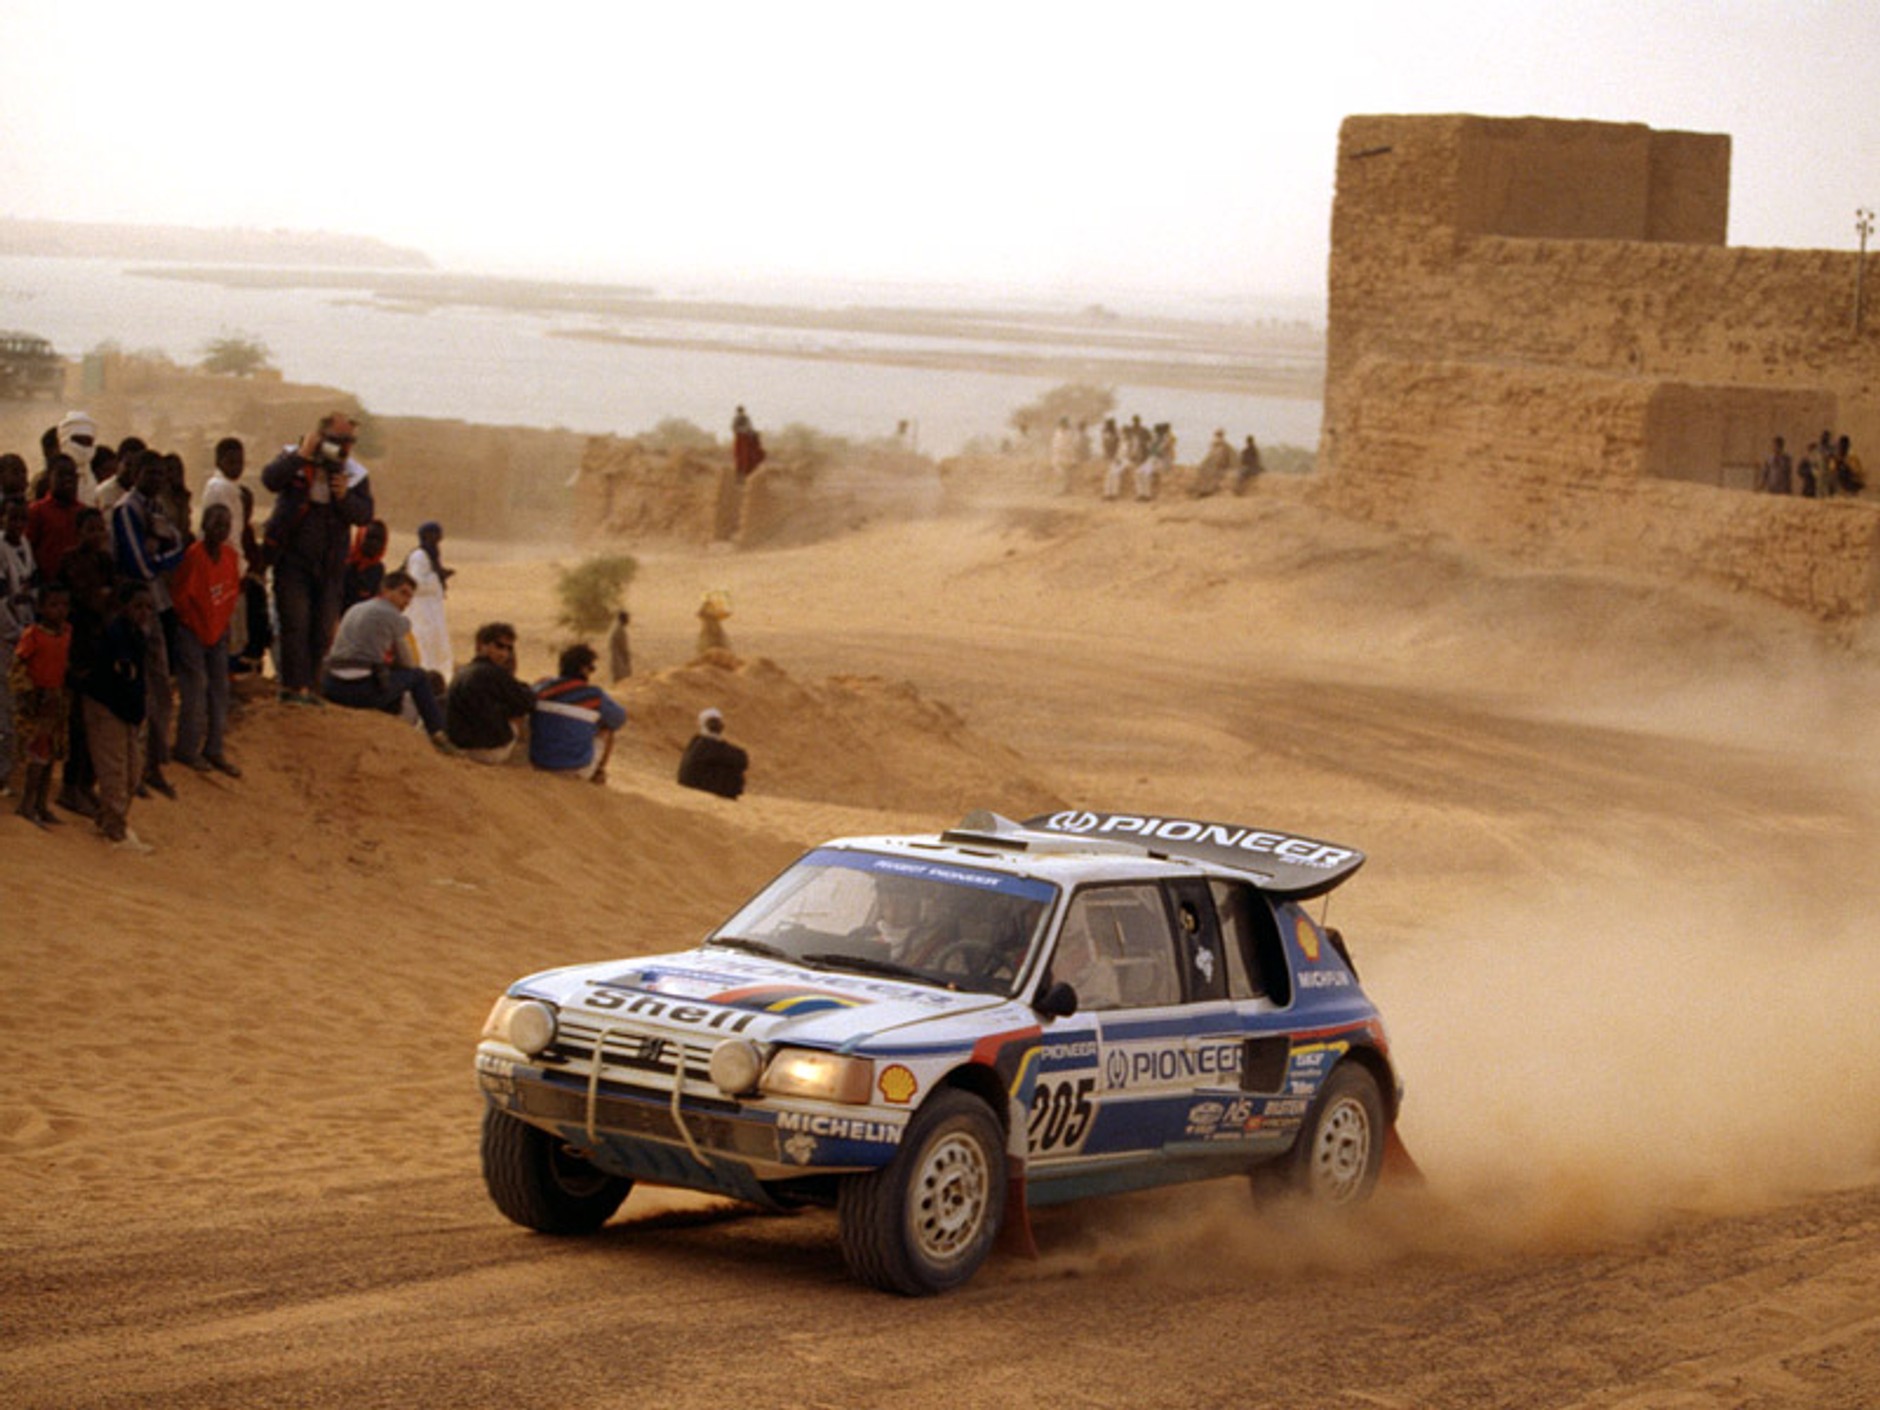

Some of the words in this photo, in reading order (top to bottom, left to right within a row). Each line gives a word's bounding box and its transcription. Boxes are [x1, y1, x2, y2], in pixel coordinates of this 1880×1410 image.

[1099, 815, 1353, 866] PIONEER
[585, 990, 757, 1034] Shell
[1041, 1041, 1097, 1060] PIONEER
[777, 1111, 901, 1144] MICHELIN
[1027, 1077, 1096, 1153] 205
